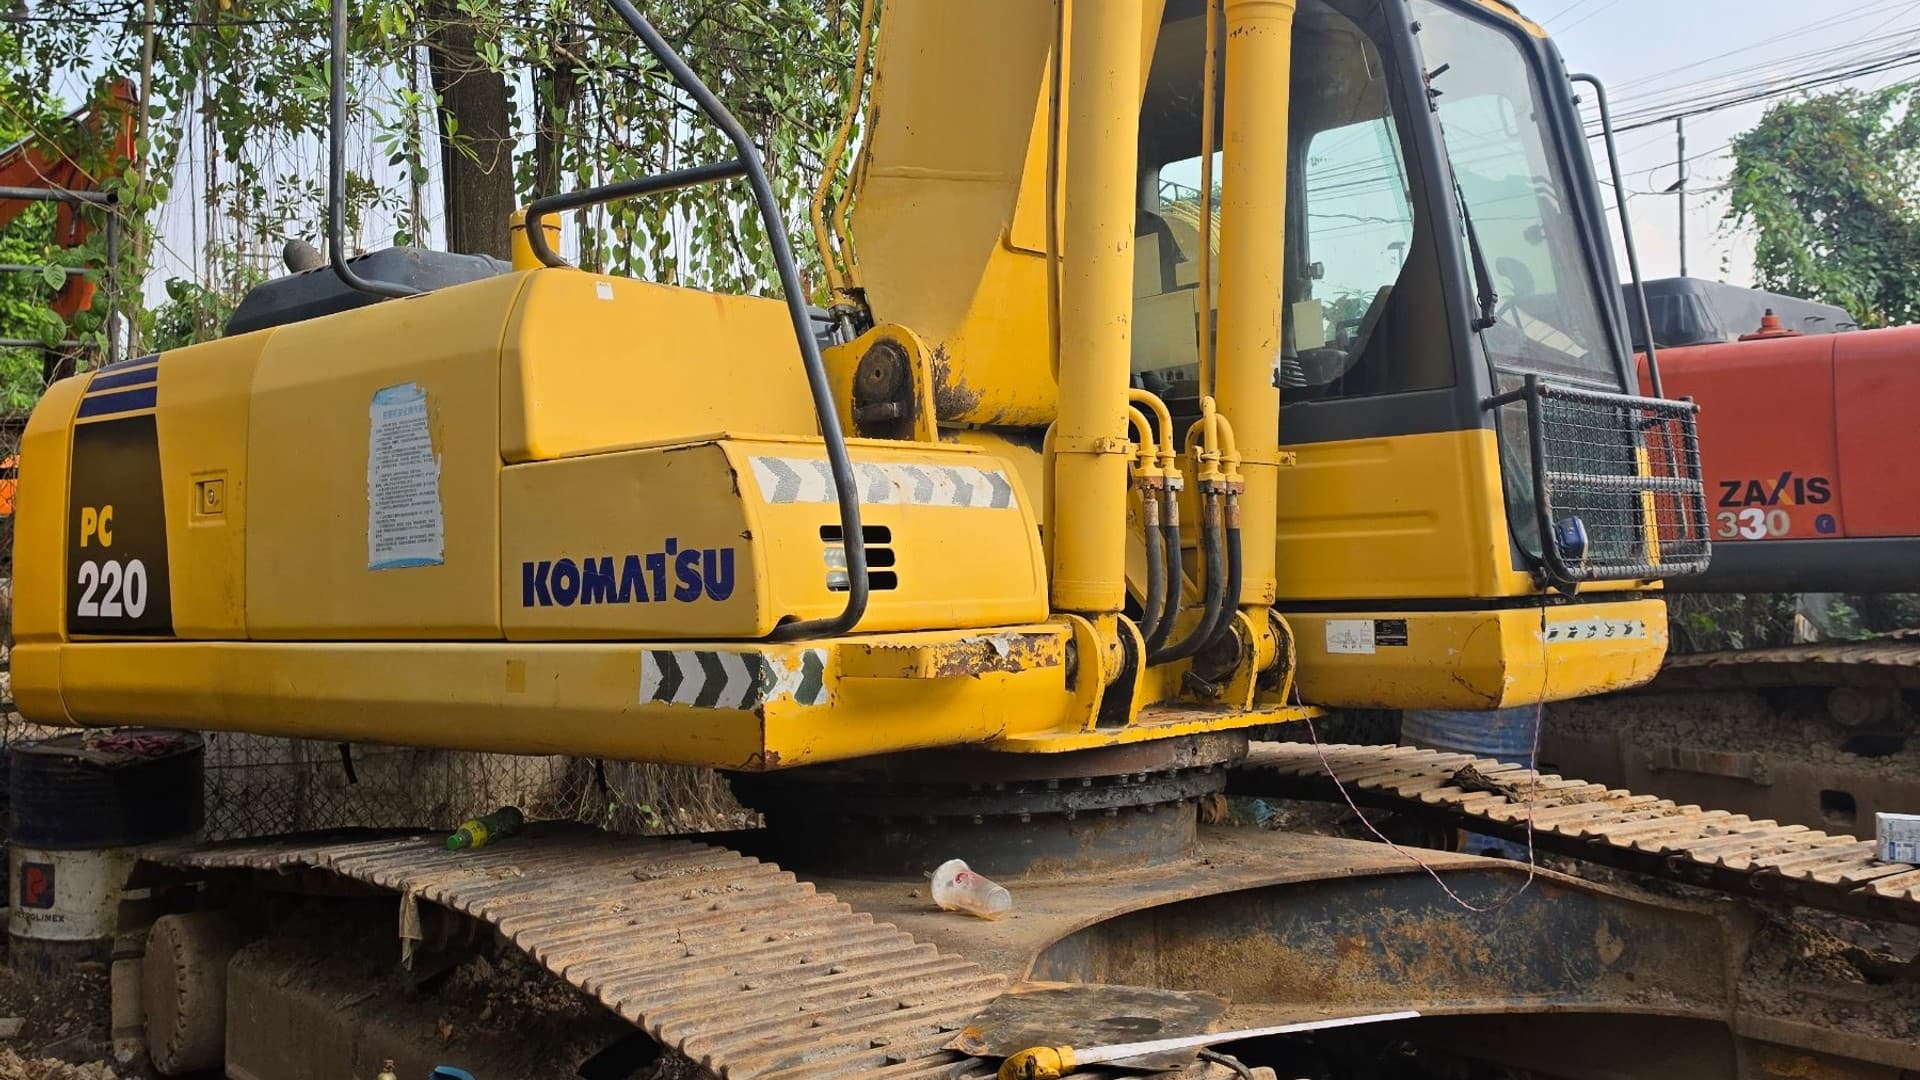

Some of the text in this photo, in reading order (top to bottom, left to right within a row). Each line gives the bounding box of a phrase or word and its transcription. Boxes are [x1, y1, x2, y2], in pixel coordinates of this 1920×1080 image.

[1718, 471, 1832, 507] ZAXIS
[80, 504, 113, 547] PC
[1716, 507, 1791, 540] 330
[77, 558, 148, 618] 220
[522, 537, 735, 608] KOMATSU
